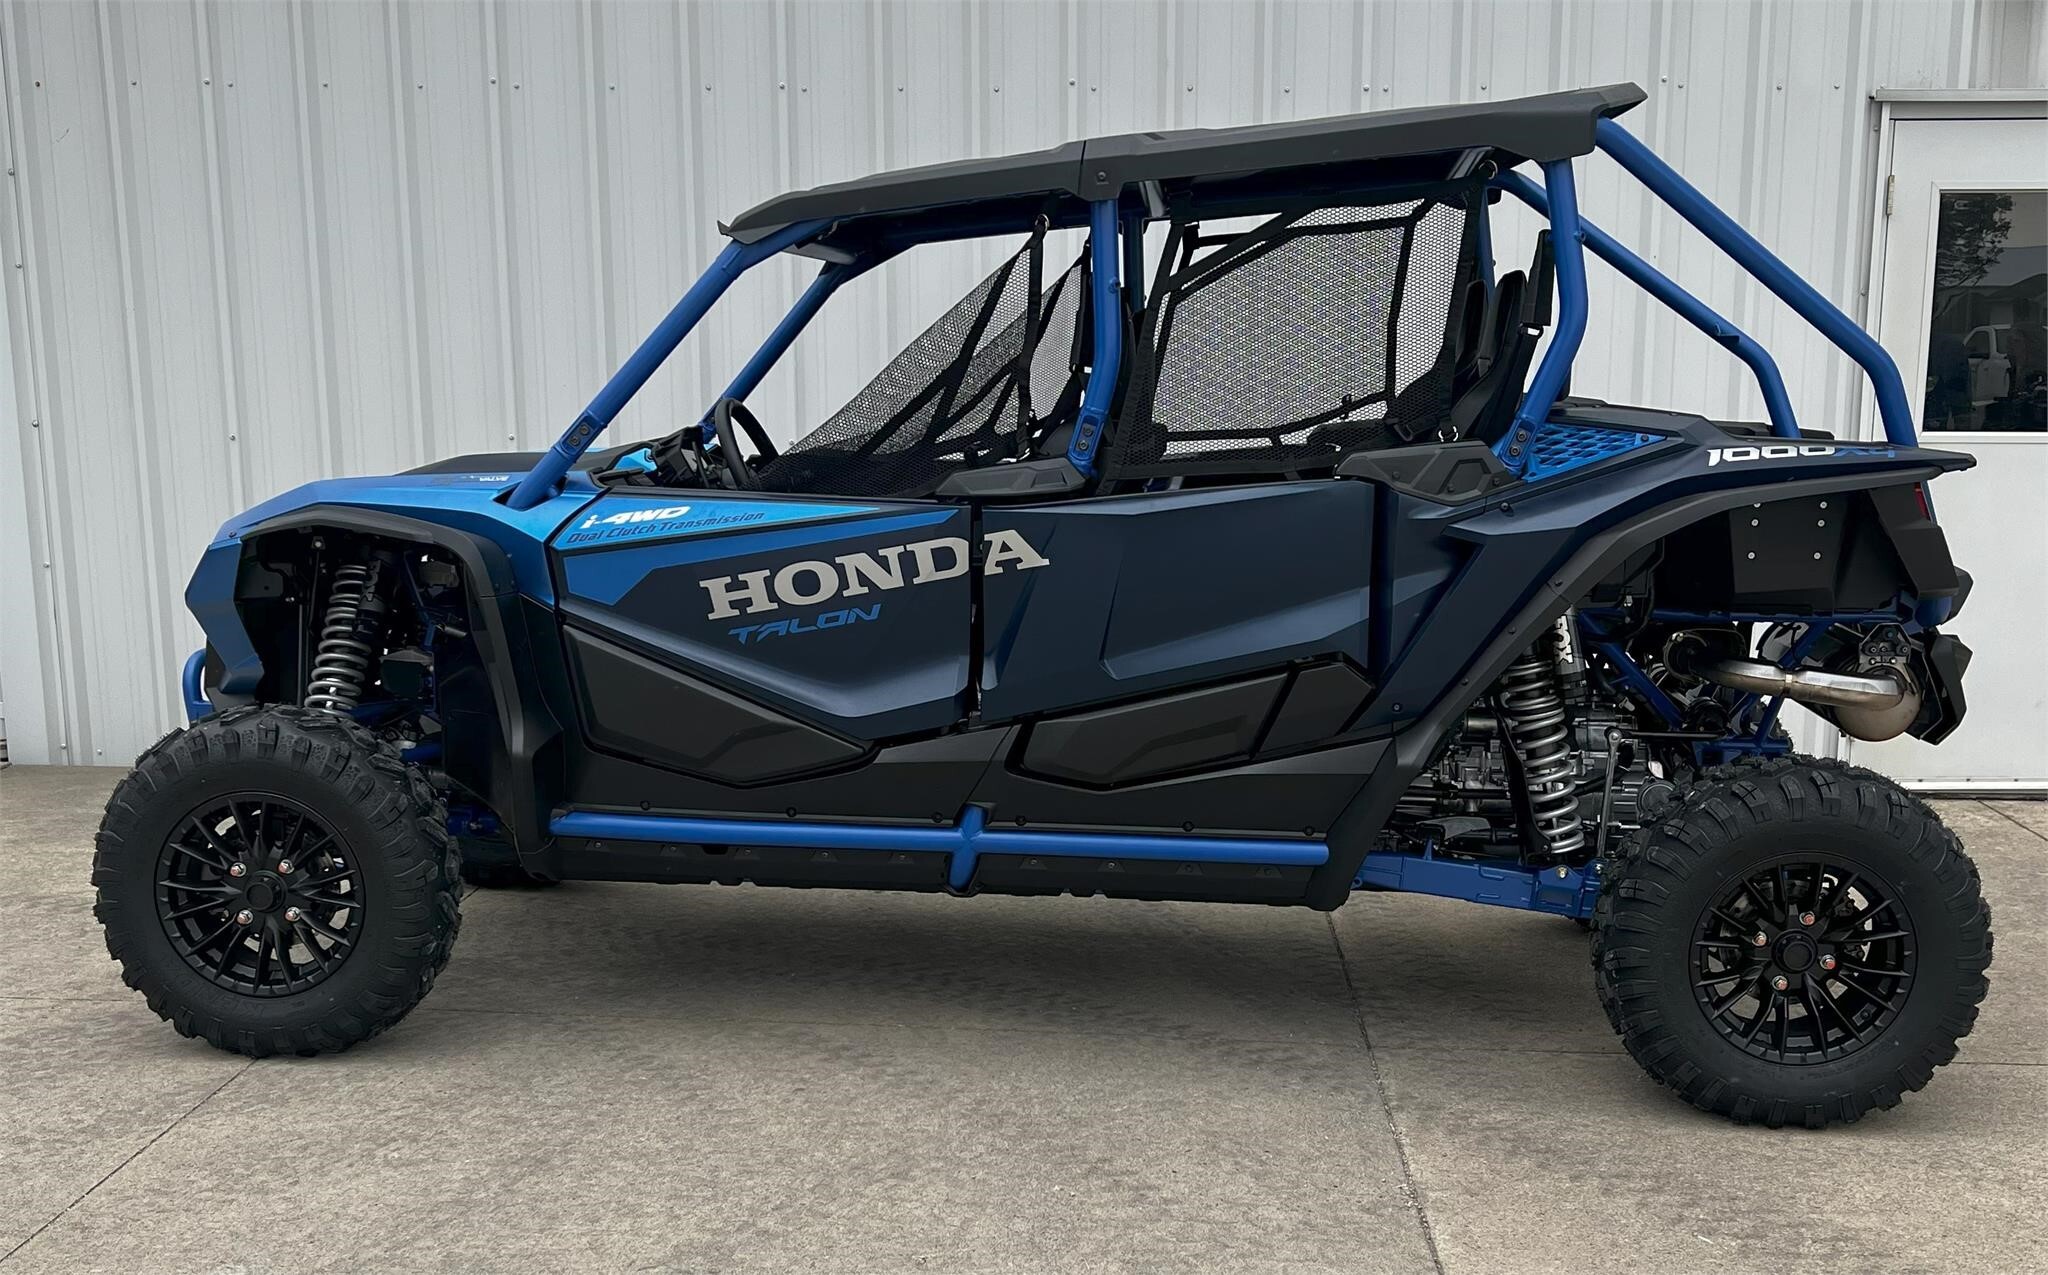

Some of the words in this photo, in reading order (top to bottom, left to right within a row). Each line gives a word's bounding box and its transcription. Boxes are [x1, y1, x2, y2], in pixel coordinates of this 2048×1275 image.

[567, 529, 604, 543] Dual
[607, 521, 657, 538] Clutch
[660, 511, 764, 532] Transmission
[580, 506, 691, 528] i-4WD
[699, 529, 1050, 620] HONDA
[728, 603, 881, 645] TALON
[1553, 615, 1574, 664] FOX
